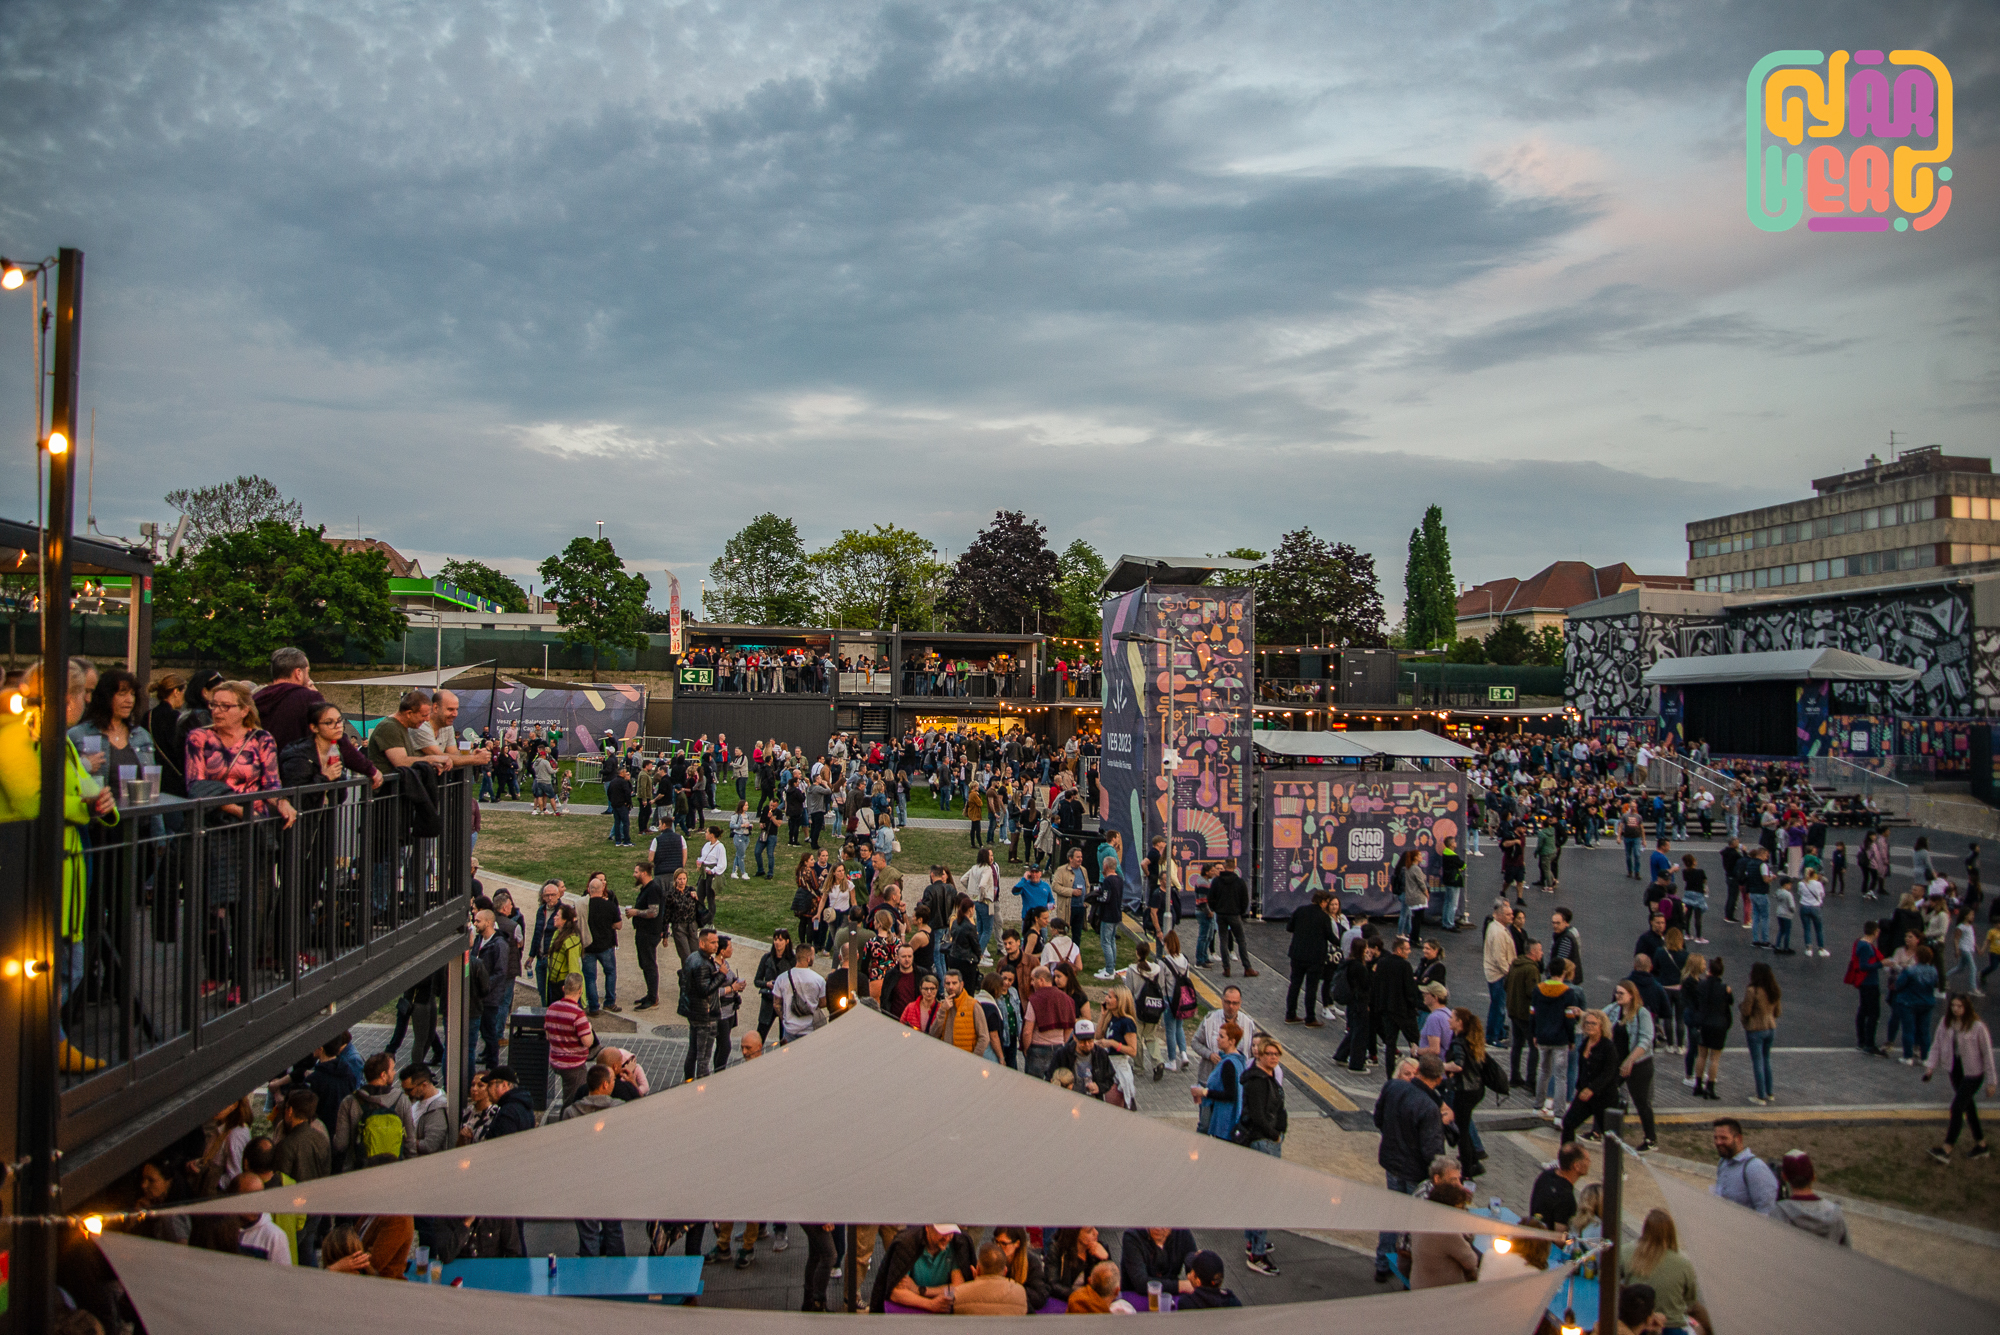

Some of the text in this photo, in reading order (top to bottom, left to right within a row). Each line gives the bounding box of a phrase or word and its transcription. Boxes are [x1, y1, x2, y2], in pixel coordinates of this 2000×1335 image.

[670, 595, 680, 636] FÉNY
[957, 716, 987, 724] BIVSTRO
[1118, 732, 1132, 753] 2023
